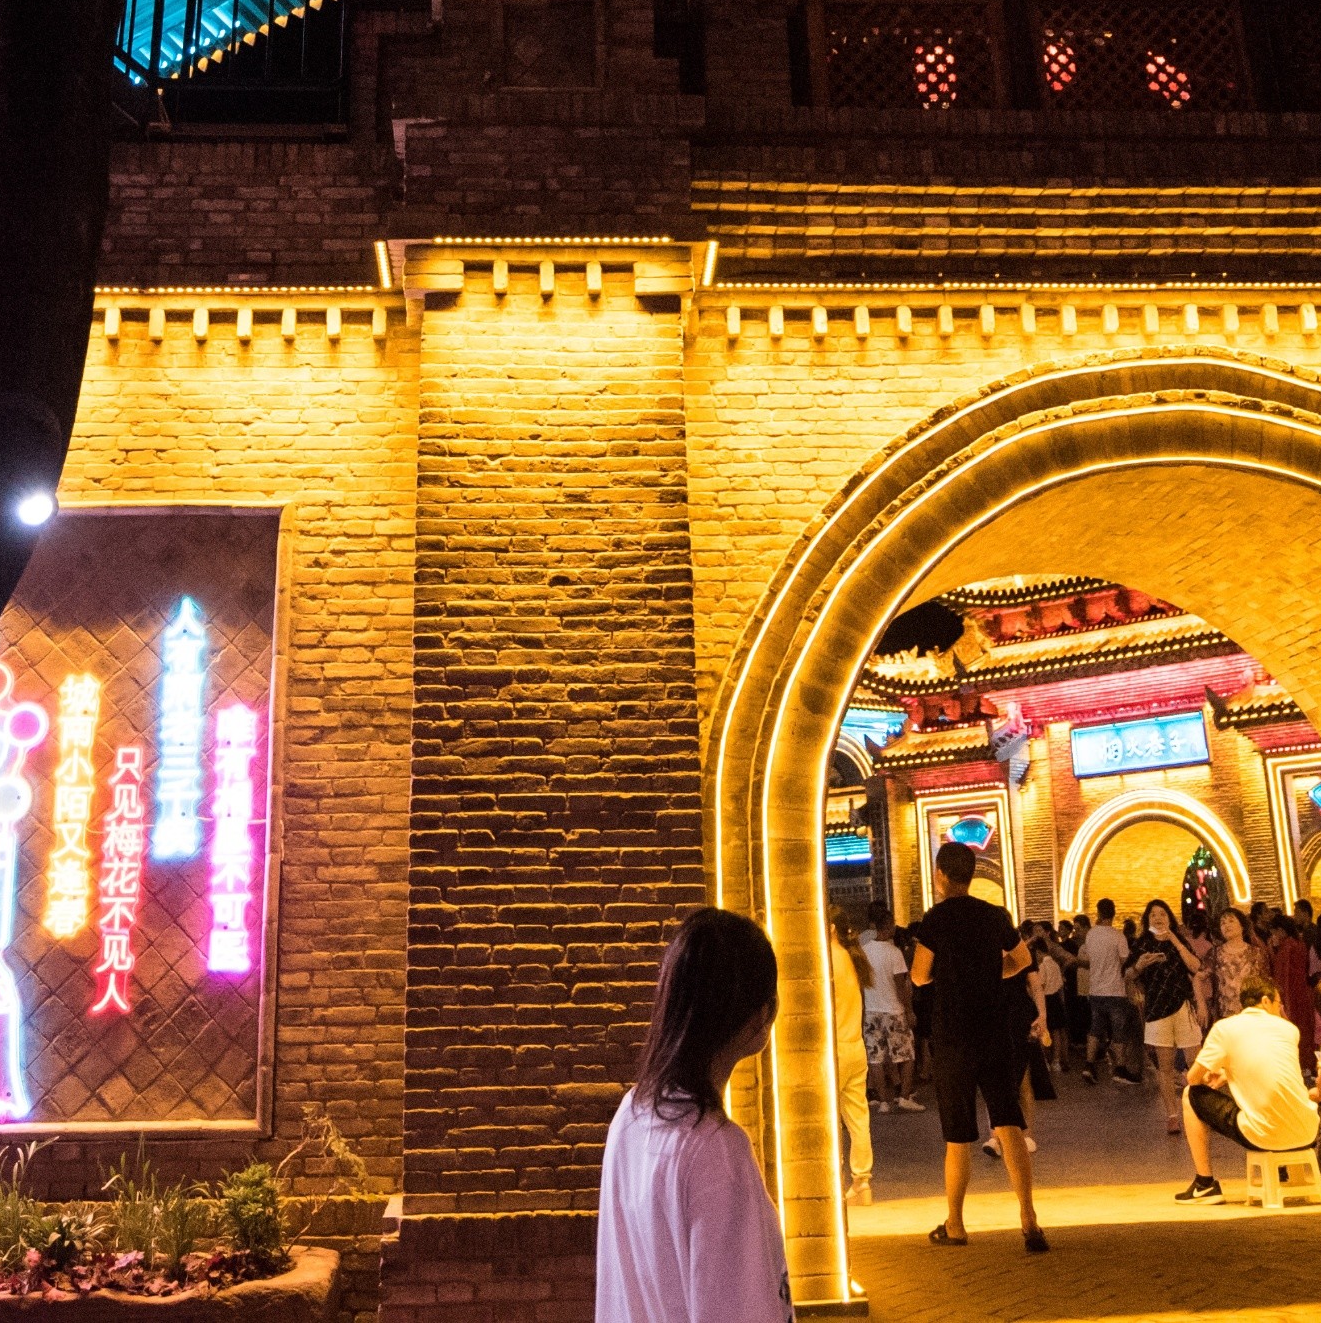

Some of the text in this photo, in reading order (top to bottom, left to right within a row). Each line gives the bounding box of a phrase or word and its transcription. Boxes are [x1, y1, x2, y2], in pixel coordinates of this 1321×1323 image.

[94, 746, 139, 1012] 只见梅花不见人
